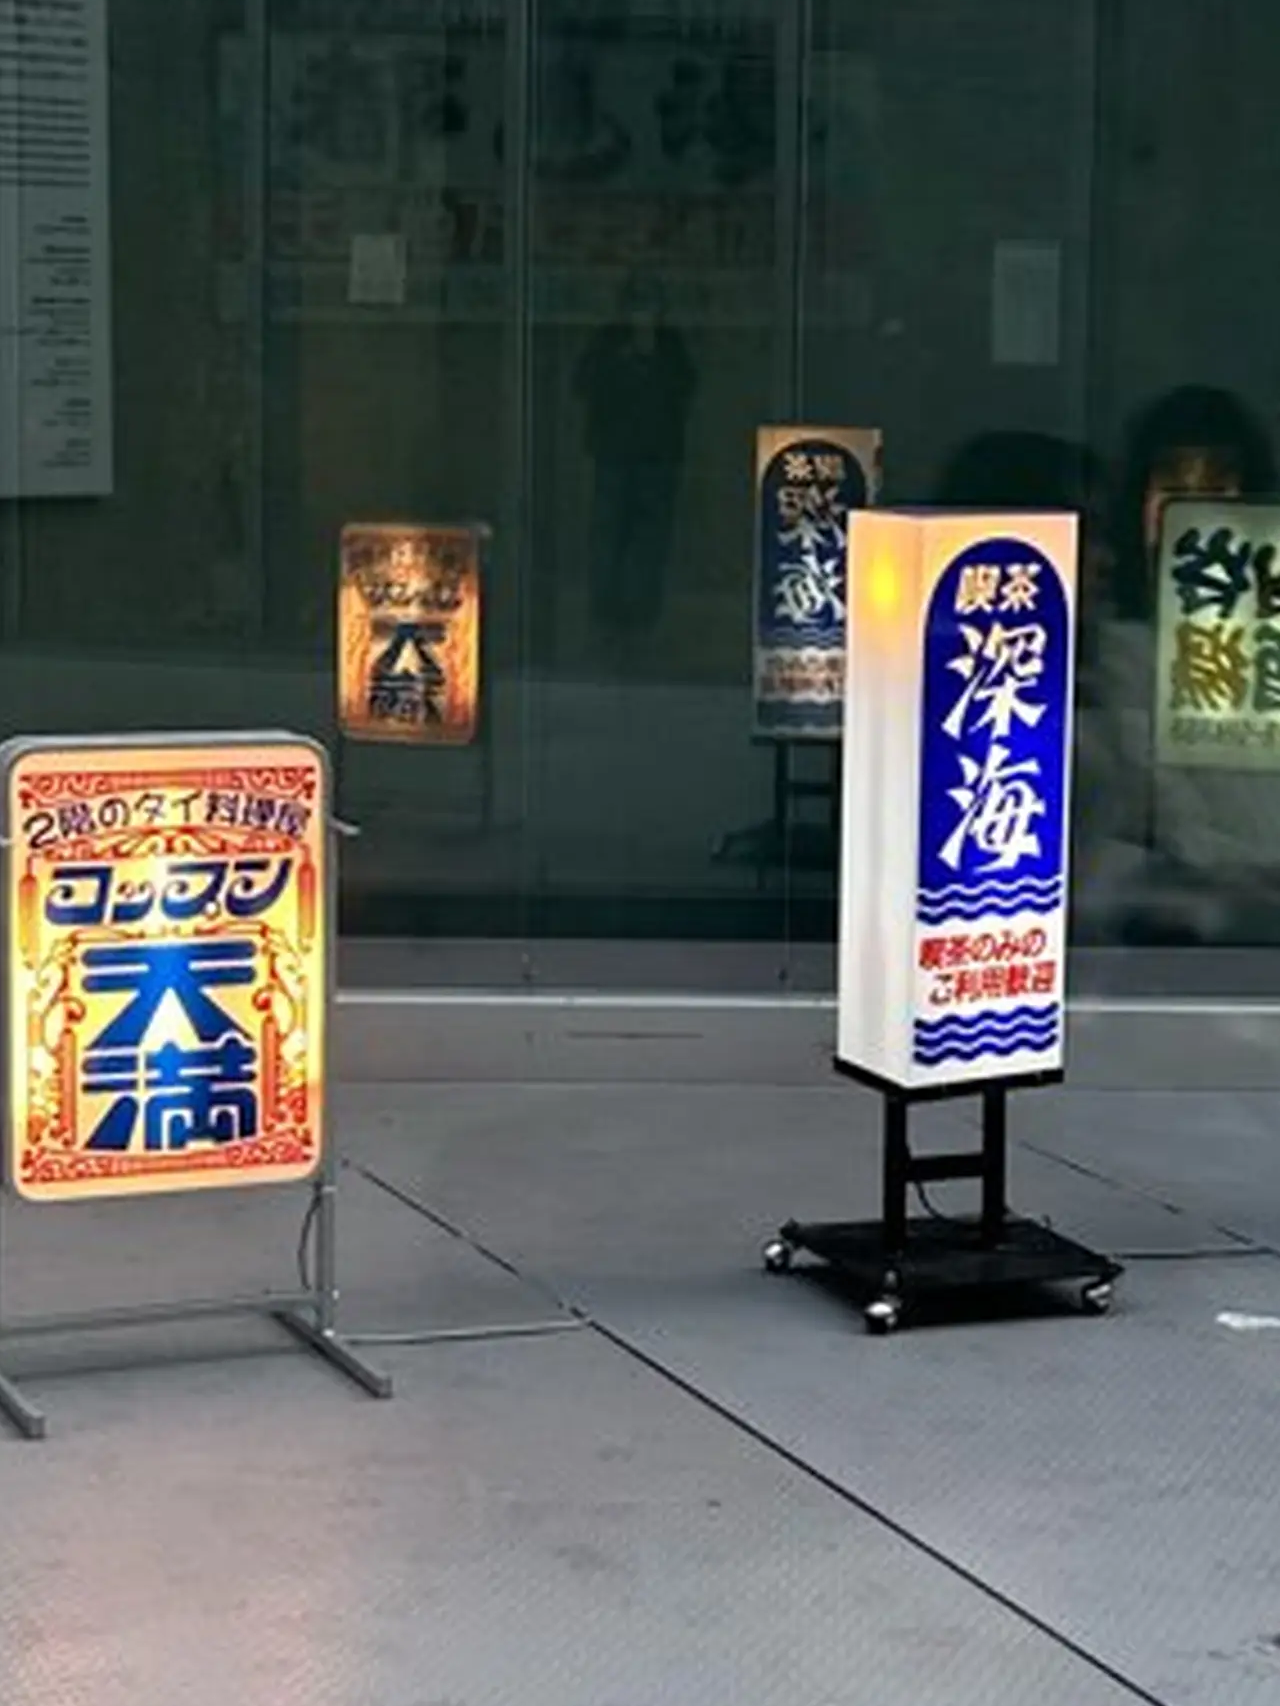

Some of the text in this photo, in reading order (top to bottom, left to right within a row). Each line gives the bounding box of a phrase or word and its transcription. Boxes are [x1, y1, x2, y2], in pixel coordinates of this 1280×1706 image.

[955, 562, 1043, 615] 喫茶
[938, 623, 1049, 876] 深海
[918, 927, 1048, 970] 喫茶のみの
[82, 941, 258, 1151] 天満
